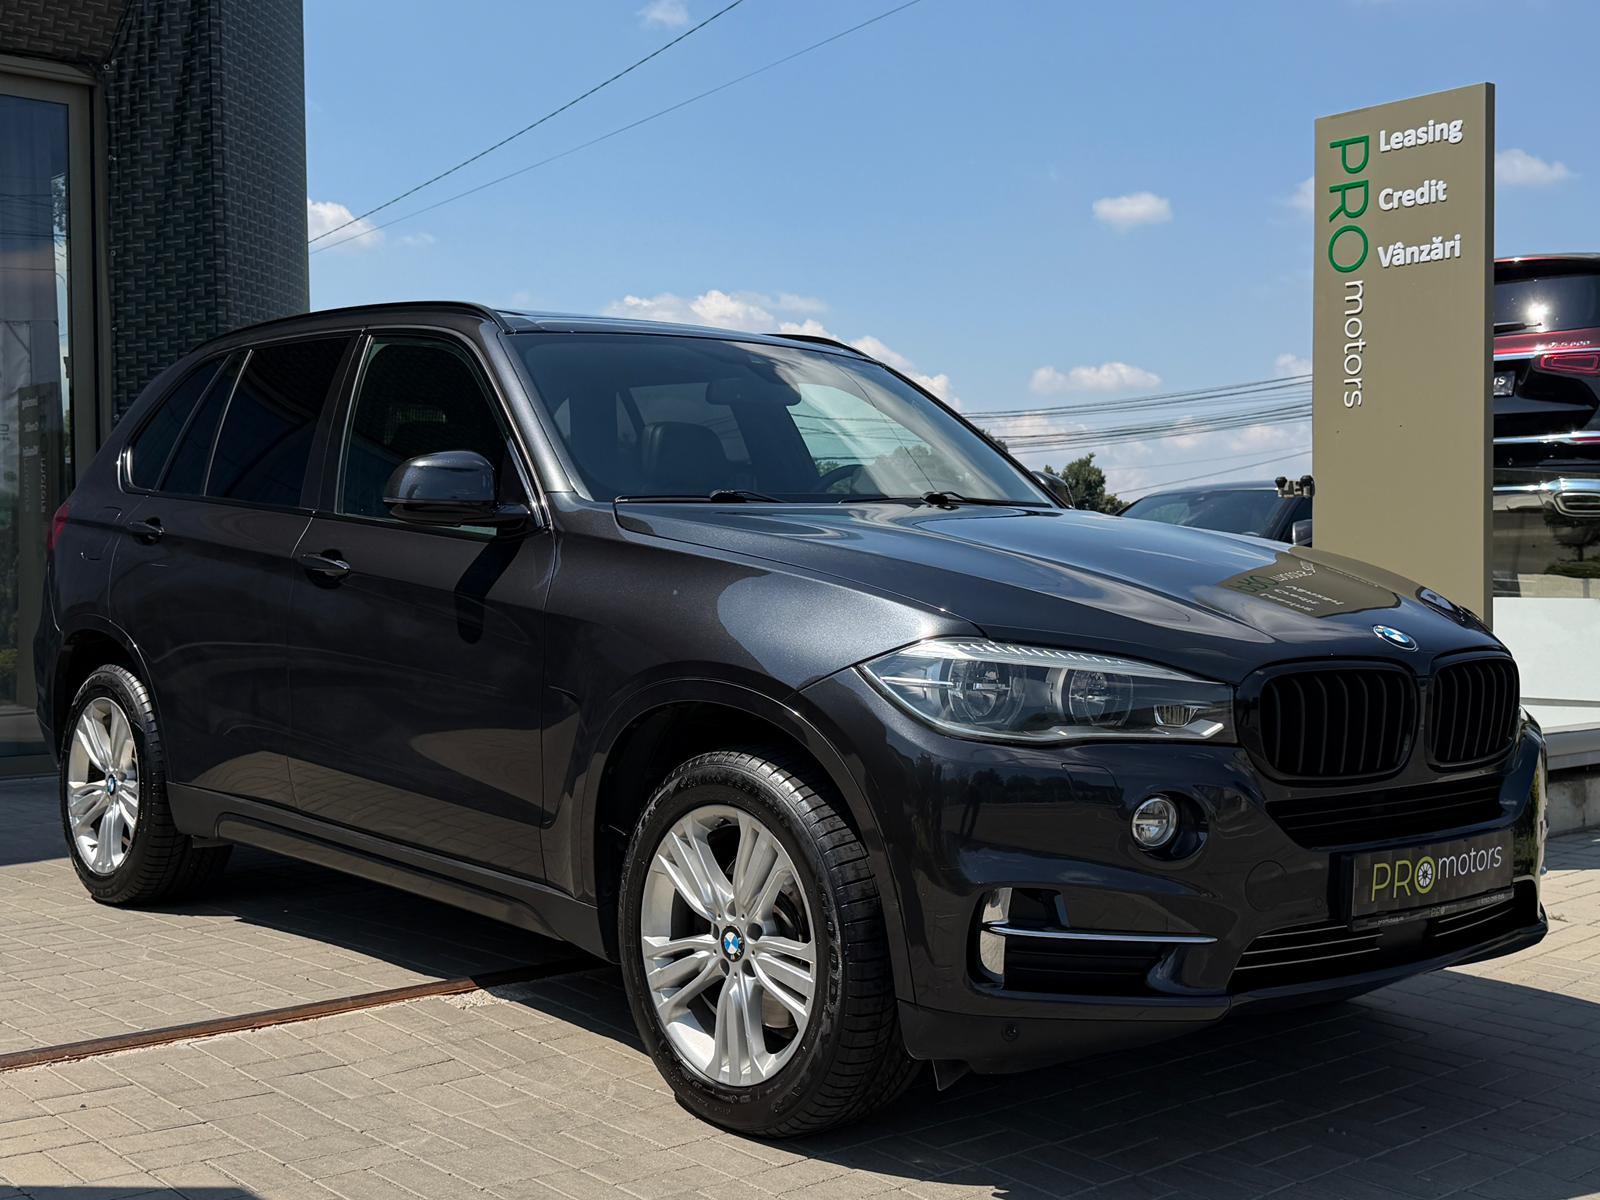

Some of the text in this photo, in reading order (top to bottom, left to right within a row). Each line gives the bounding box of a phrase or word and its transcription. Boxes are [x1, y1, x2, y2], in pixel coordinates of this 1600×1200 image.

[1379, 119, 1463, 152] Leasing
[1378, 179, 1448, 211] Credit
[1377, 234, 1461, 268] Vânzări
